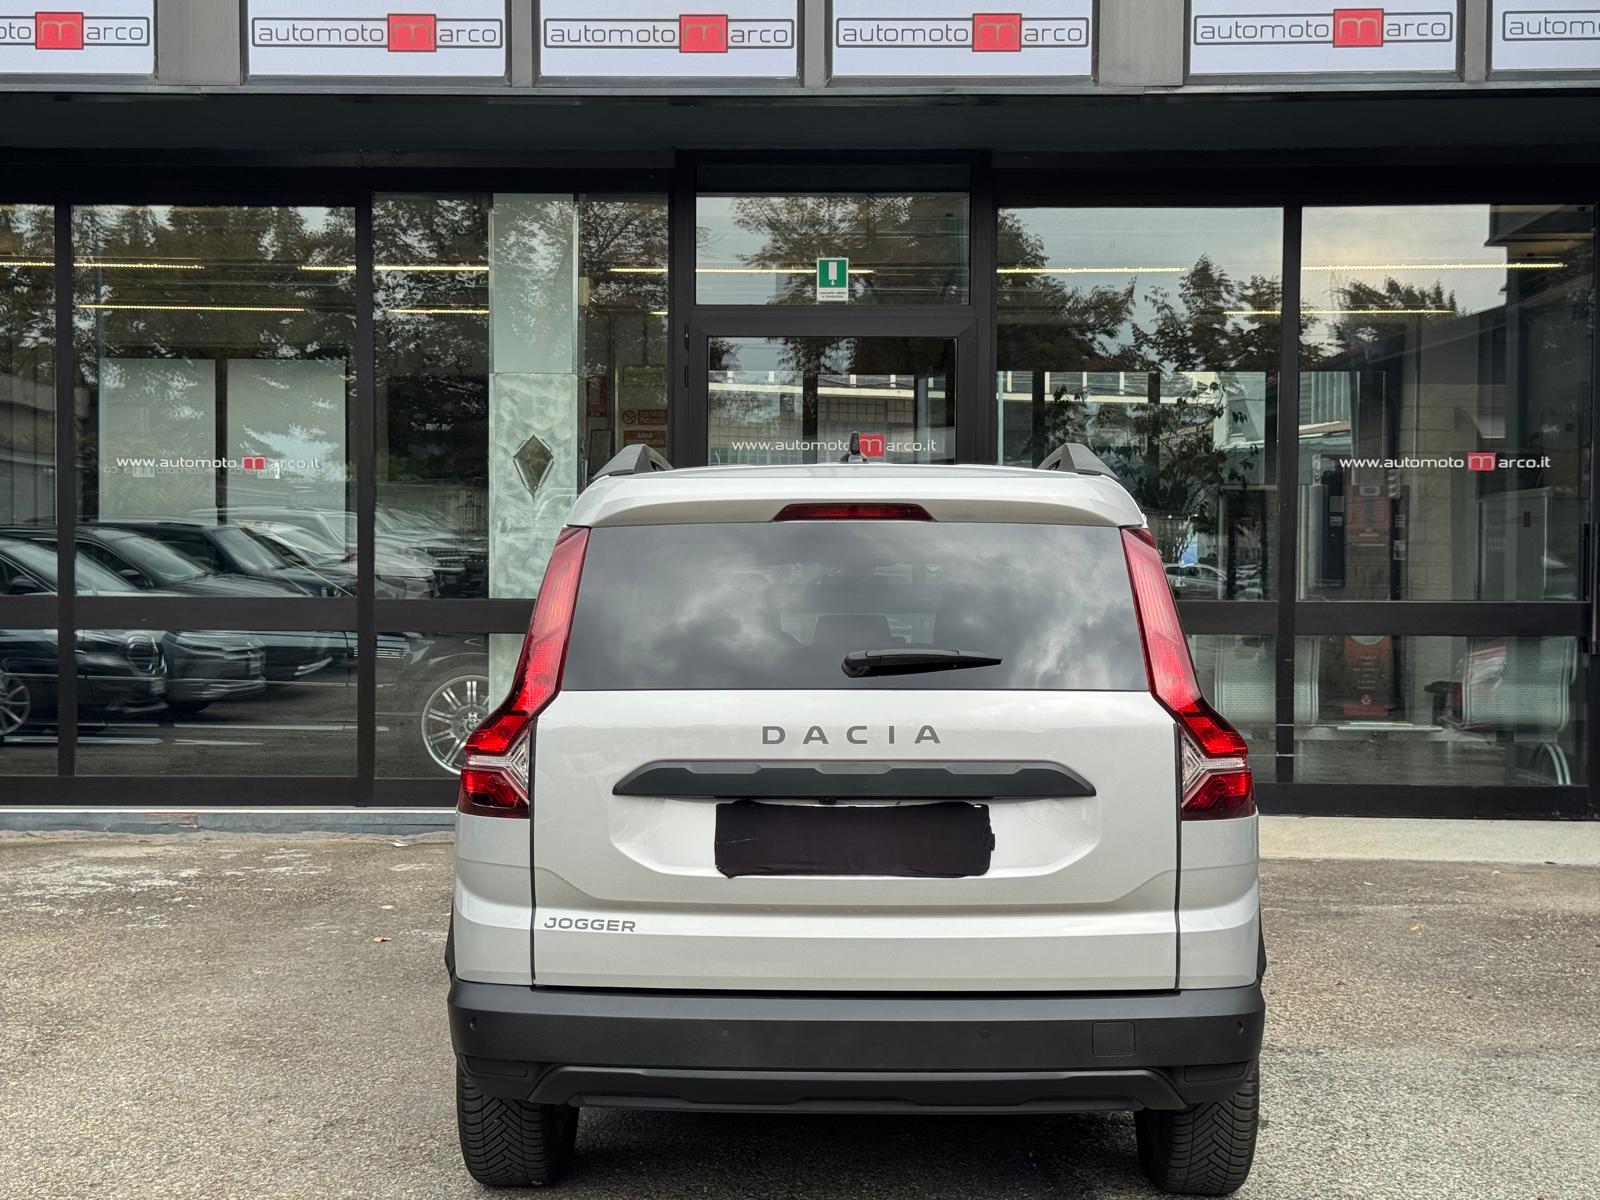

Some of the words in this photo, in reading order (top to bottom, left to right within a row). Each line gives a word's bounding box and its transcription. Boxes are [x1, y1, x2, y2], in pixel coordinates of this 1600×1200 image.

[1509, 17, 1600, 36] autom
[762, 725, 941, 745] DACIA
[544, 917, 636, 932] JOGGER
